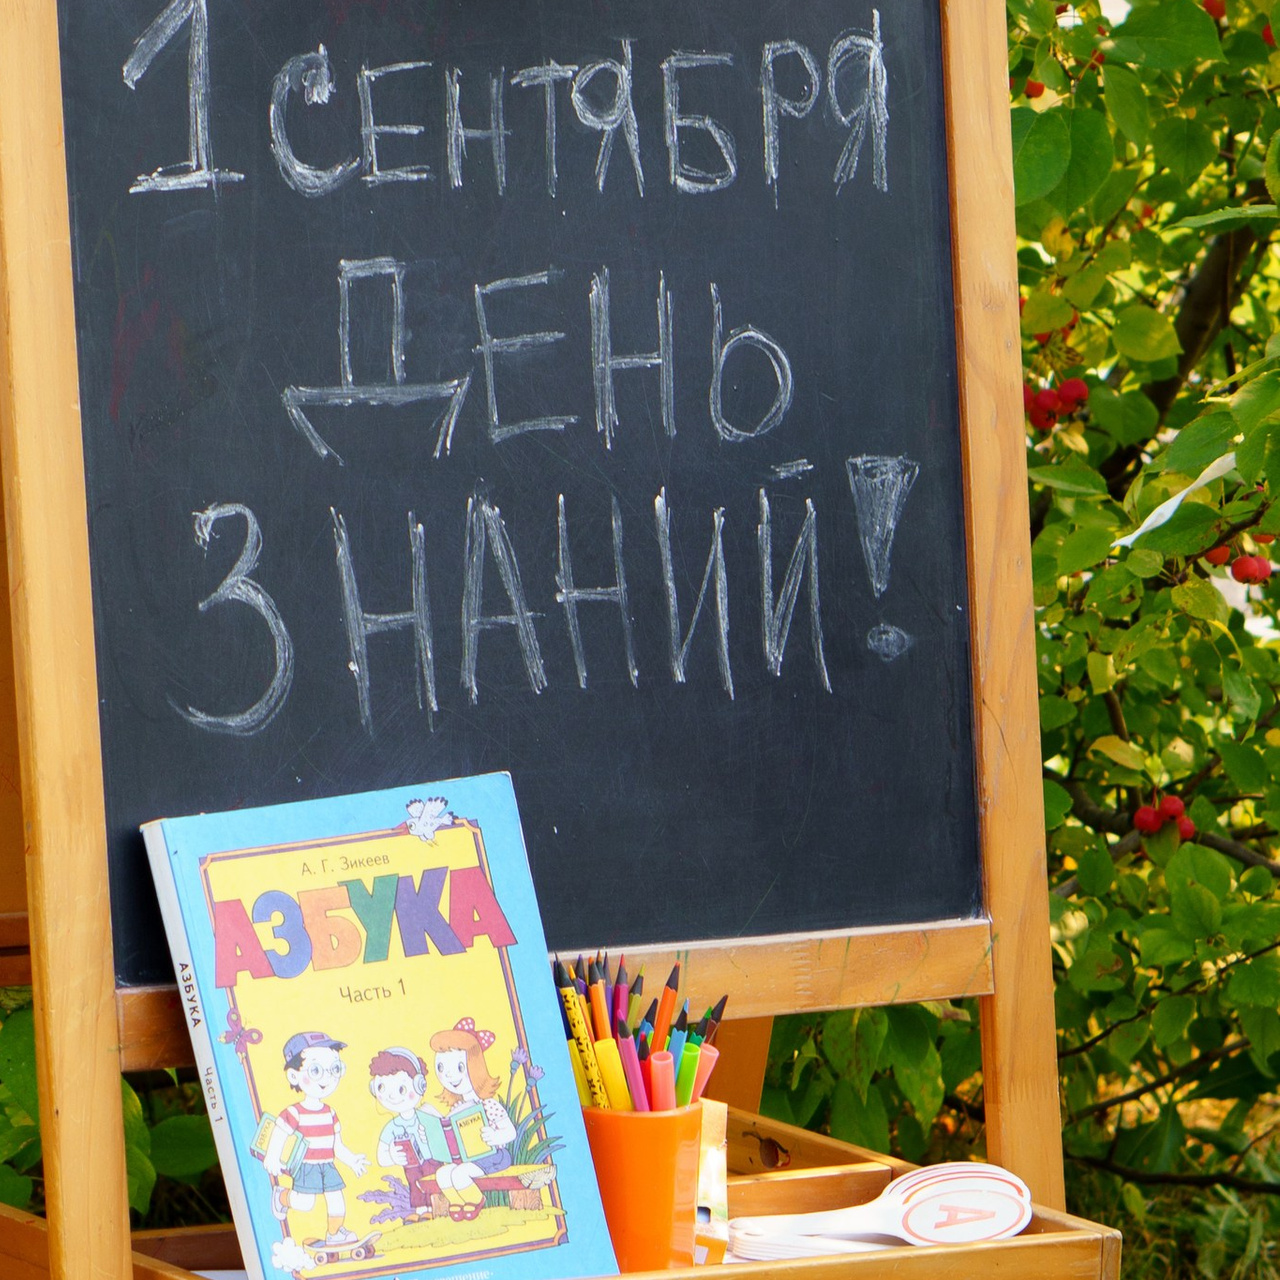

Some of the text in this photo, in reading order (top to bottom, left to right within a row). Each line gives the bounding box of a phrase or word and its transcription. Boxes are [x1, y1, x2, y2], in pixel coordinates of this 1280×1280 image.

[268, 7, 889, 209] СЕНТЯБРЯ
[281, 256, 793, 465] ДЕНЬ
[301, 853, 390, 877] А. Г. Зикеев
[214, 866, 518, 988] АЗБУКА
[178, 962, 202, 1029] АЗБУКА
[339, 977, 407, 1004] Часть 1
[204, 1066, 218, 1111] Часть
[934, 1204, 996, 1229] А
